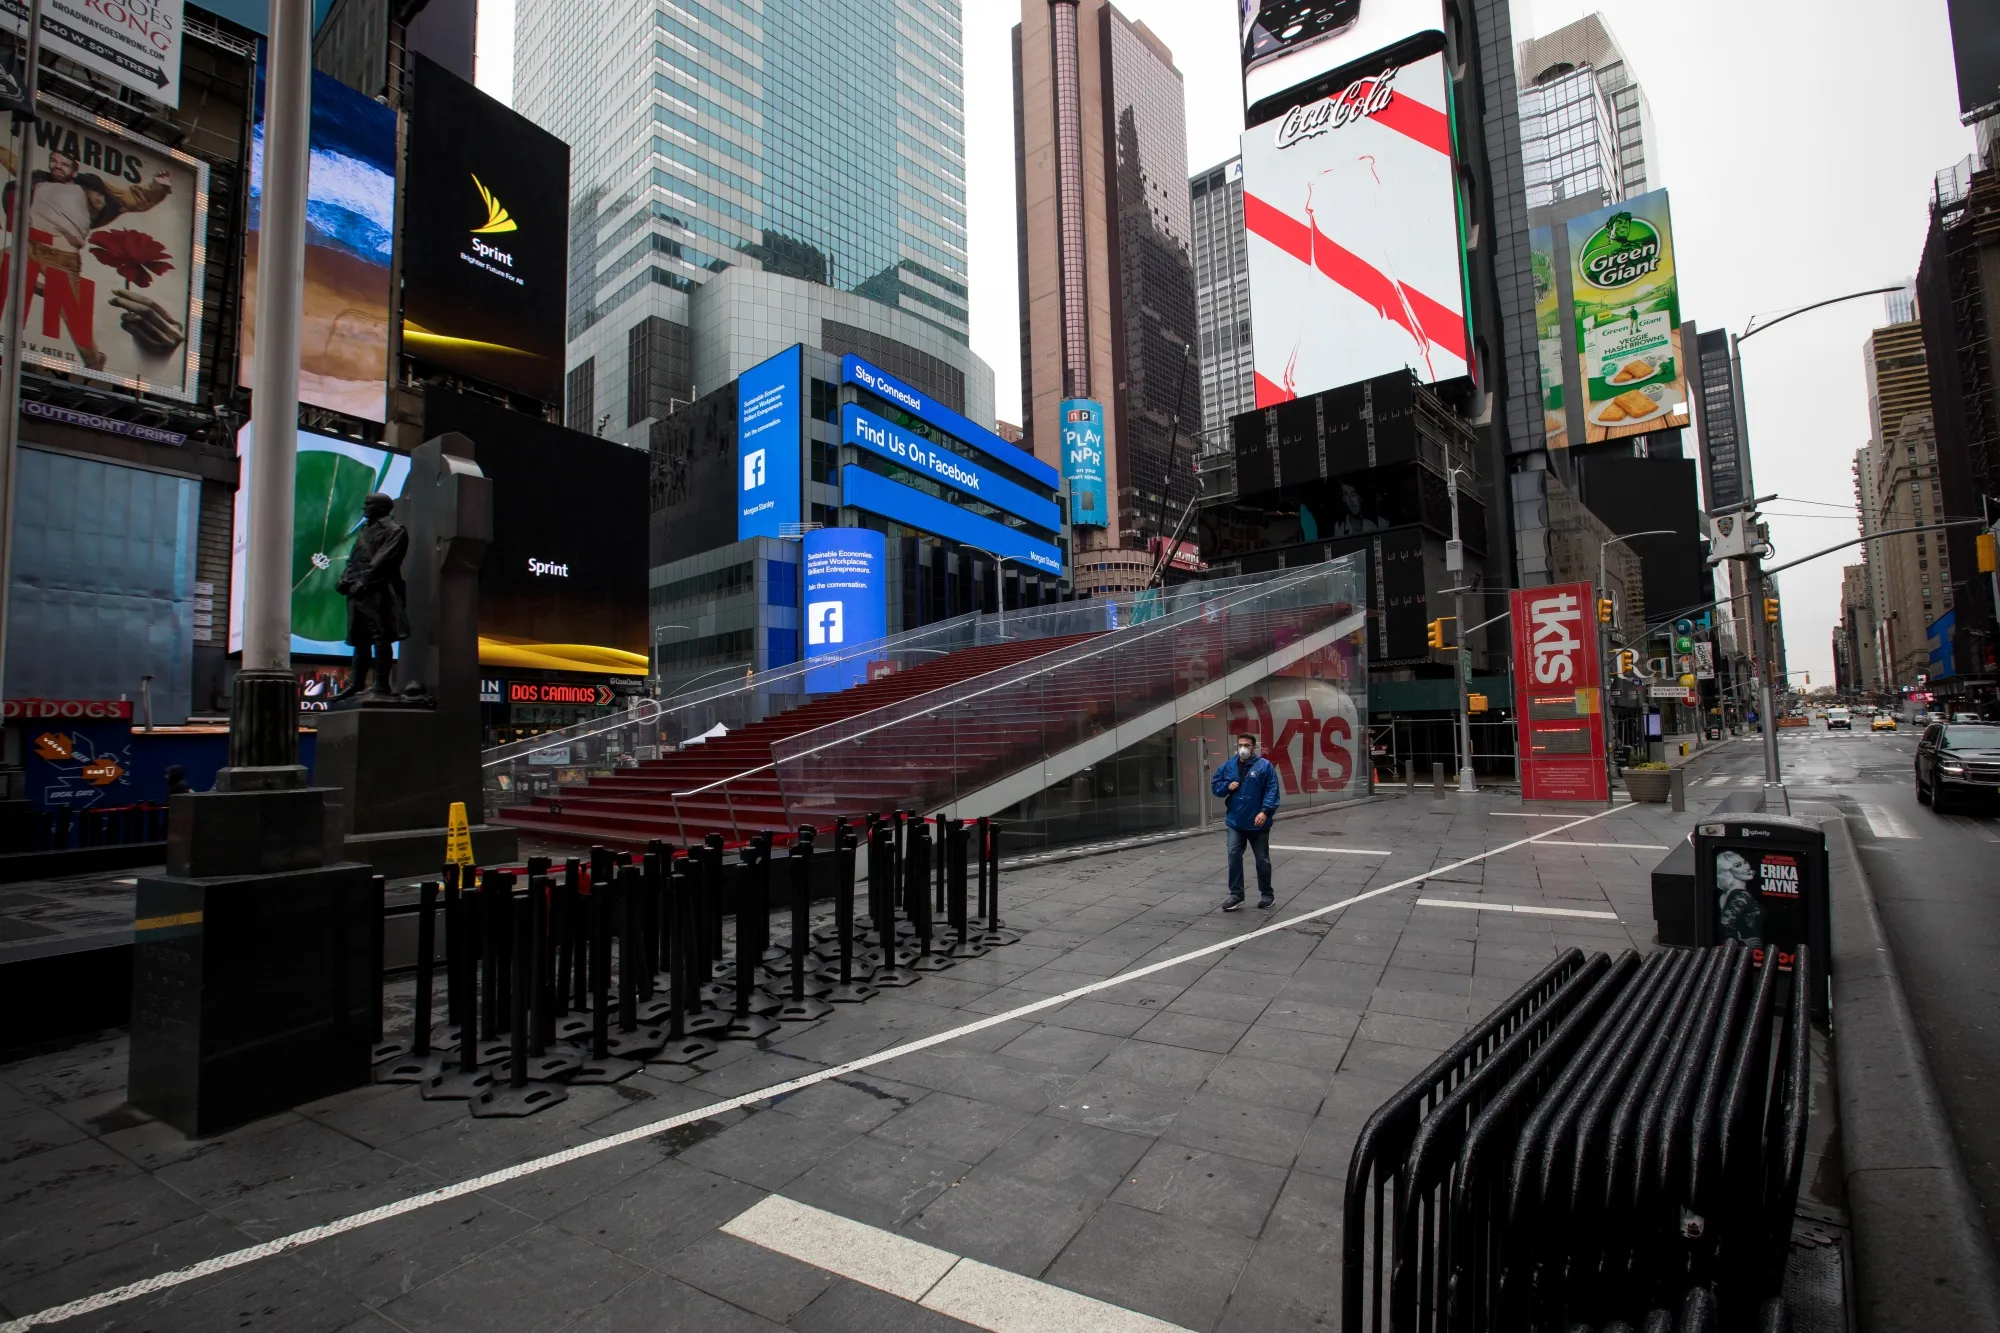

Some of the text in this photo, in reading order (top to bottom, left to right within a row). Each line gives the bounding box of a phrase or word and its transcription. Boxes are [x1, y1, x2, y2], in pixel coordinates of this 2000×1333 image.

[52, 1, 165, 62] BROADWAYGOESWRONG.COM
[43, 20, 159, 80] 340 W. 50TH STREET
[472, 237, 513, 267] Sprint
[1589, 243, 1656, 272] Green
[460, 252, 524, 285] Brighter Future For All
[1598, 257, 1660, 285] Giant
[1602, 316, 1663, 336] Green Giant
[1604, 334, 1665, 355] HASH BROWNS
[1619, 332, 1649, 345] VEGGIE
[855, 365, 921, 410] Stay Connected
[744, 394, 764, 407] Sustainable
[1069, 411, 1097, 422] npr
[856, 417, 980, 490] Find Us On Facebook
[743, 500, 775, 516] Morgan Stanley
[808, 550, 873, 560] Sustainable Economies.
[808, 558, 868, 568] Inclusive Workplaces.
[1030, 550, 1060, 571] Morgan Stanley
[528, 558, 568, 577] Sprint
[808, 566, 871, 575] Brilliant Entrepreneurs.
[1531, 593, 1580, 684] tkts
[1695, 644, 1713, 676] MORMON
[511, 685, 595, 702] DOS CAMINOS
[1760, 863, 1799, 881] ERIKA
[1760, 878, 1799, 894] JAYNE
